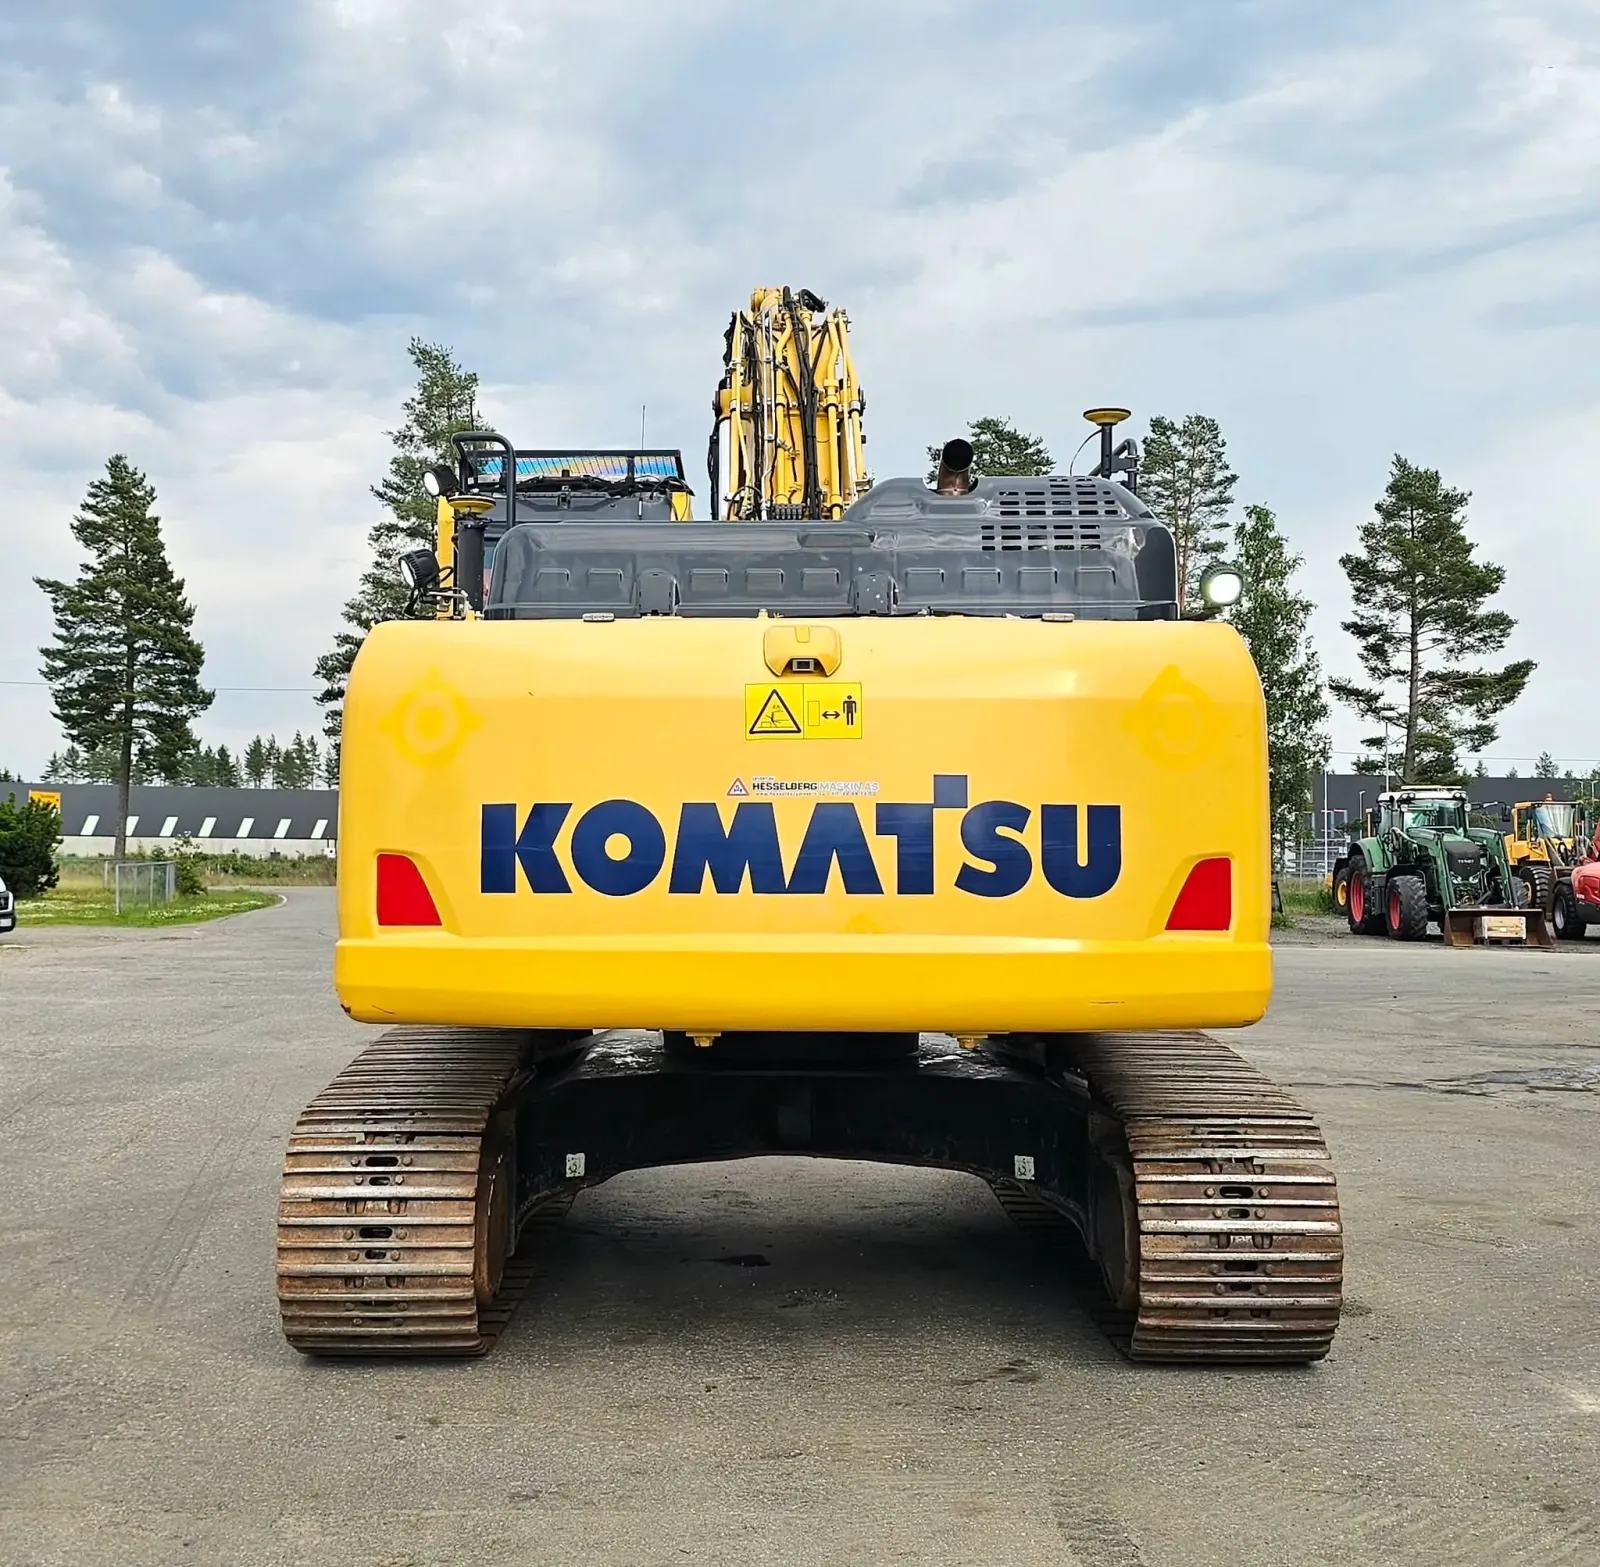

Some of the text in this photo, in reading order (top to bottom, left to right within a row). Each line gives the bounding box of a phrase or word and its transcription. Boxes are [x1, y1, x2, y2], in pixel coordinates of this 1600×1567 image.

[752, 782, 879, 791] HESSELBERG MASKIN AS
[481, 774, 1122, 898] KOMATSU
